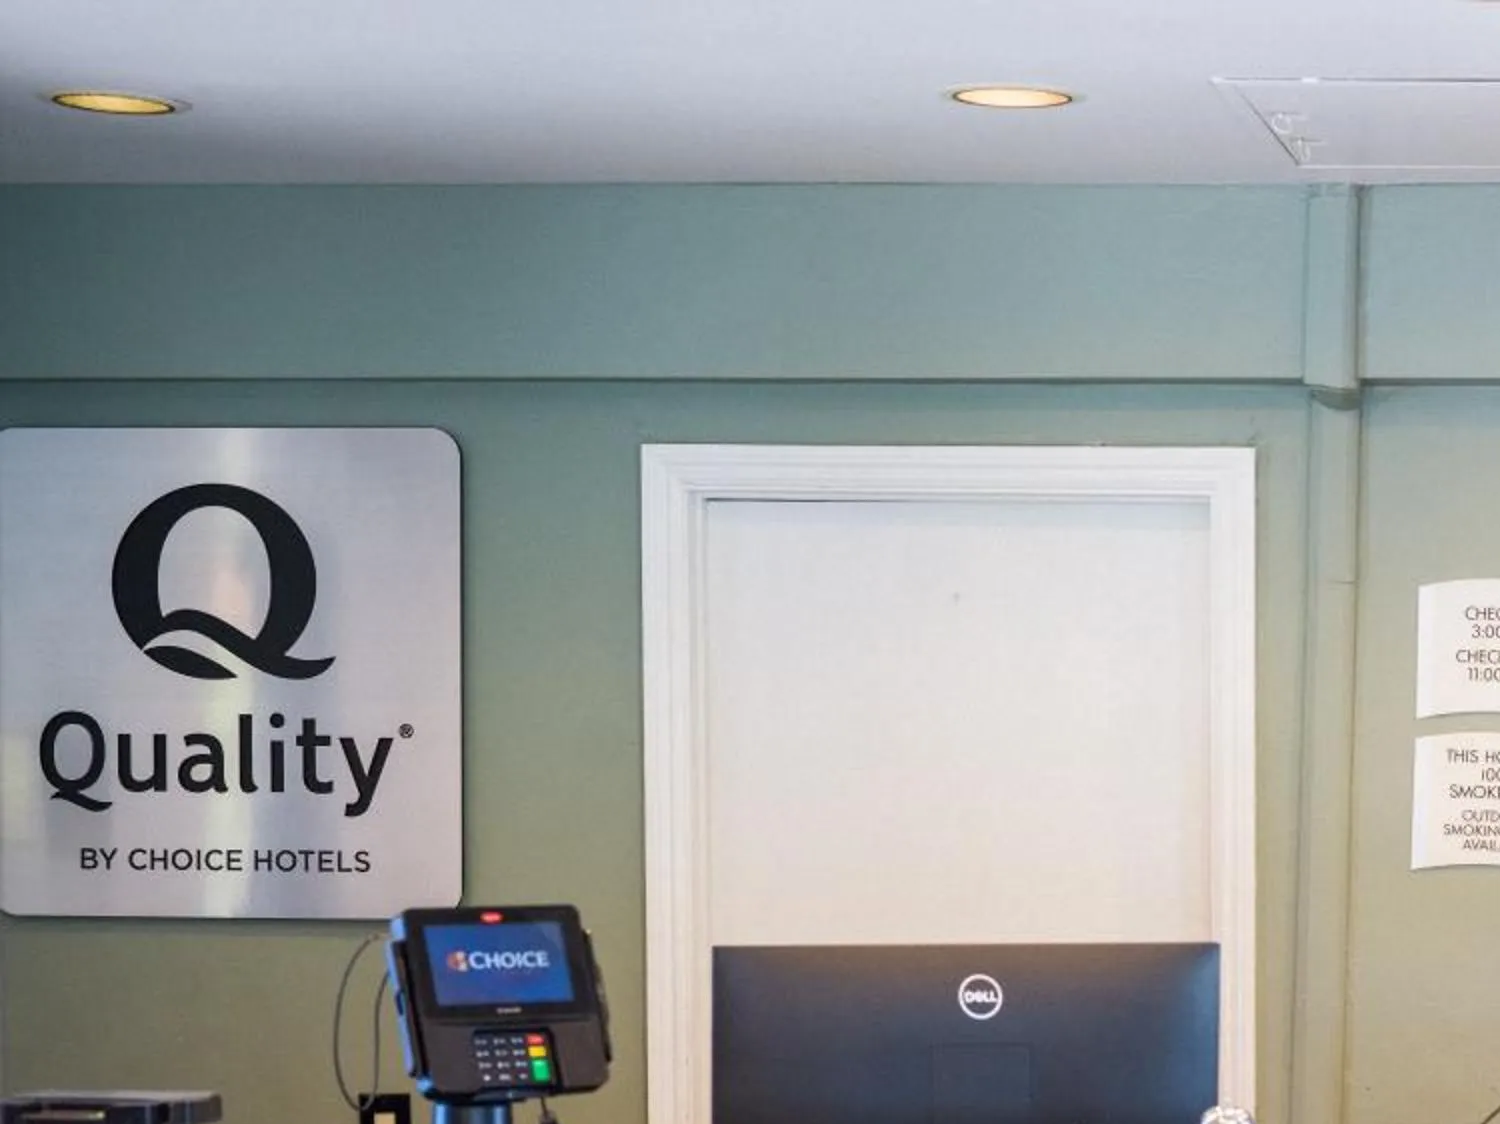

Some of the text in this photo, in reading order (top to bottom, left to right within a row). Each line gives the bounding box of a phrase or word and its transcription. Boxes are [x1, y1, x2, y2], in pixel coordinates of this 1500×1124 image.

[1447, 749, 1479, 765] THIS
[80, 848, 371, 873] BY CHOICE HOTELS
[470, 951, 549, 969] CHOICE
[965, 990, 998, 1003] DELL
